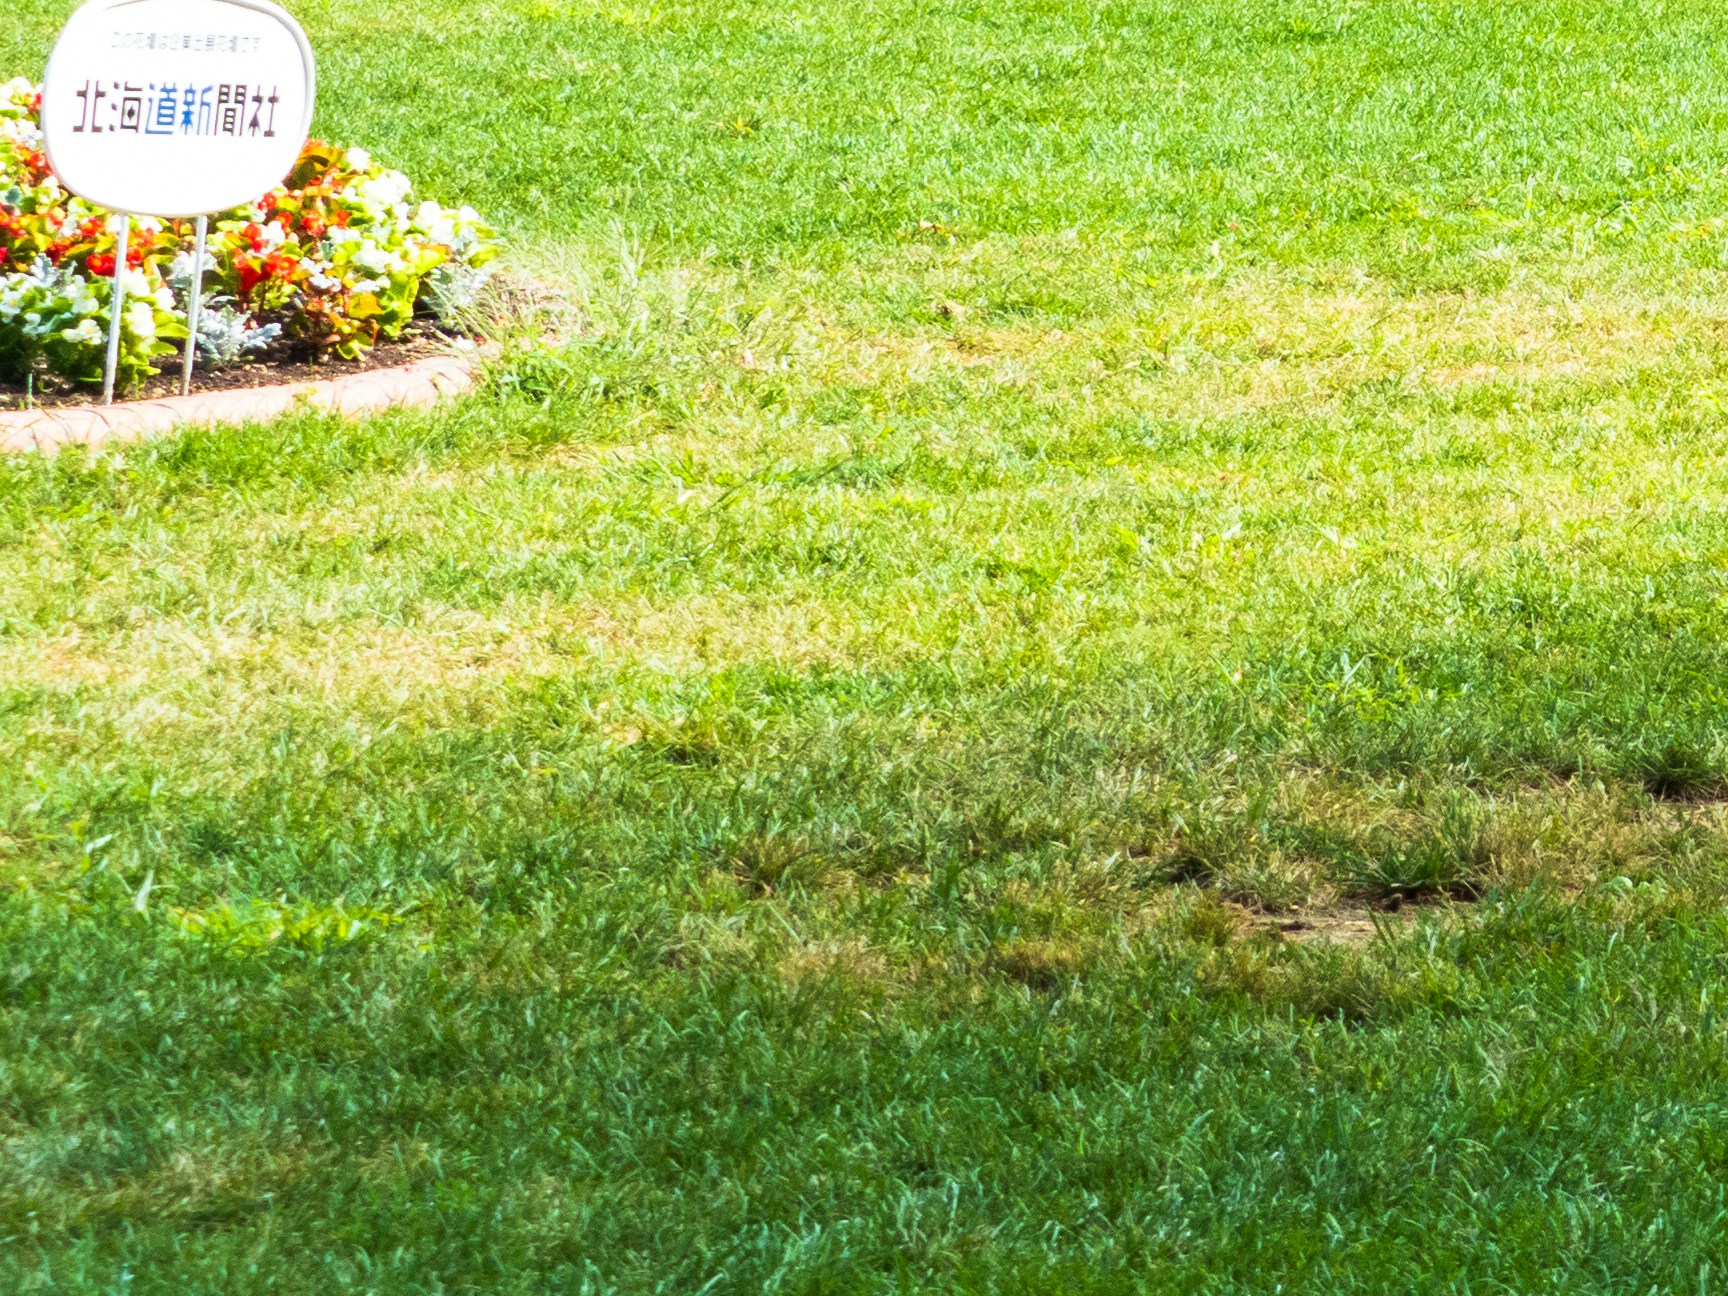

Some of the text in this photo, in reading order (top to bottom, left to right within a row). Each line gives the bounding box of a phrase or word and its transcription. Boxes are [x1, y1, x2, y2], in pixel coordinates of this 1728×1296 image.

[73, 79, 280, 138] 北海道新聞社
